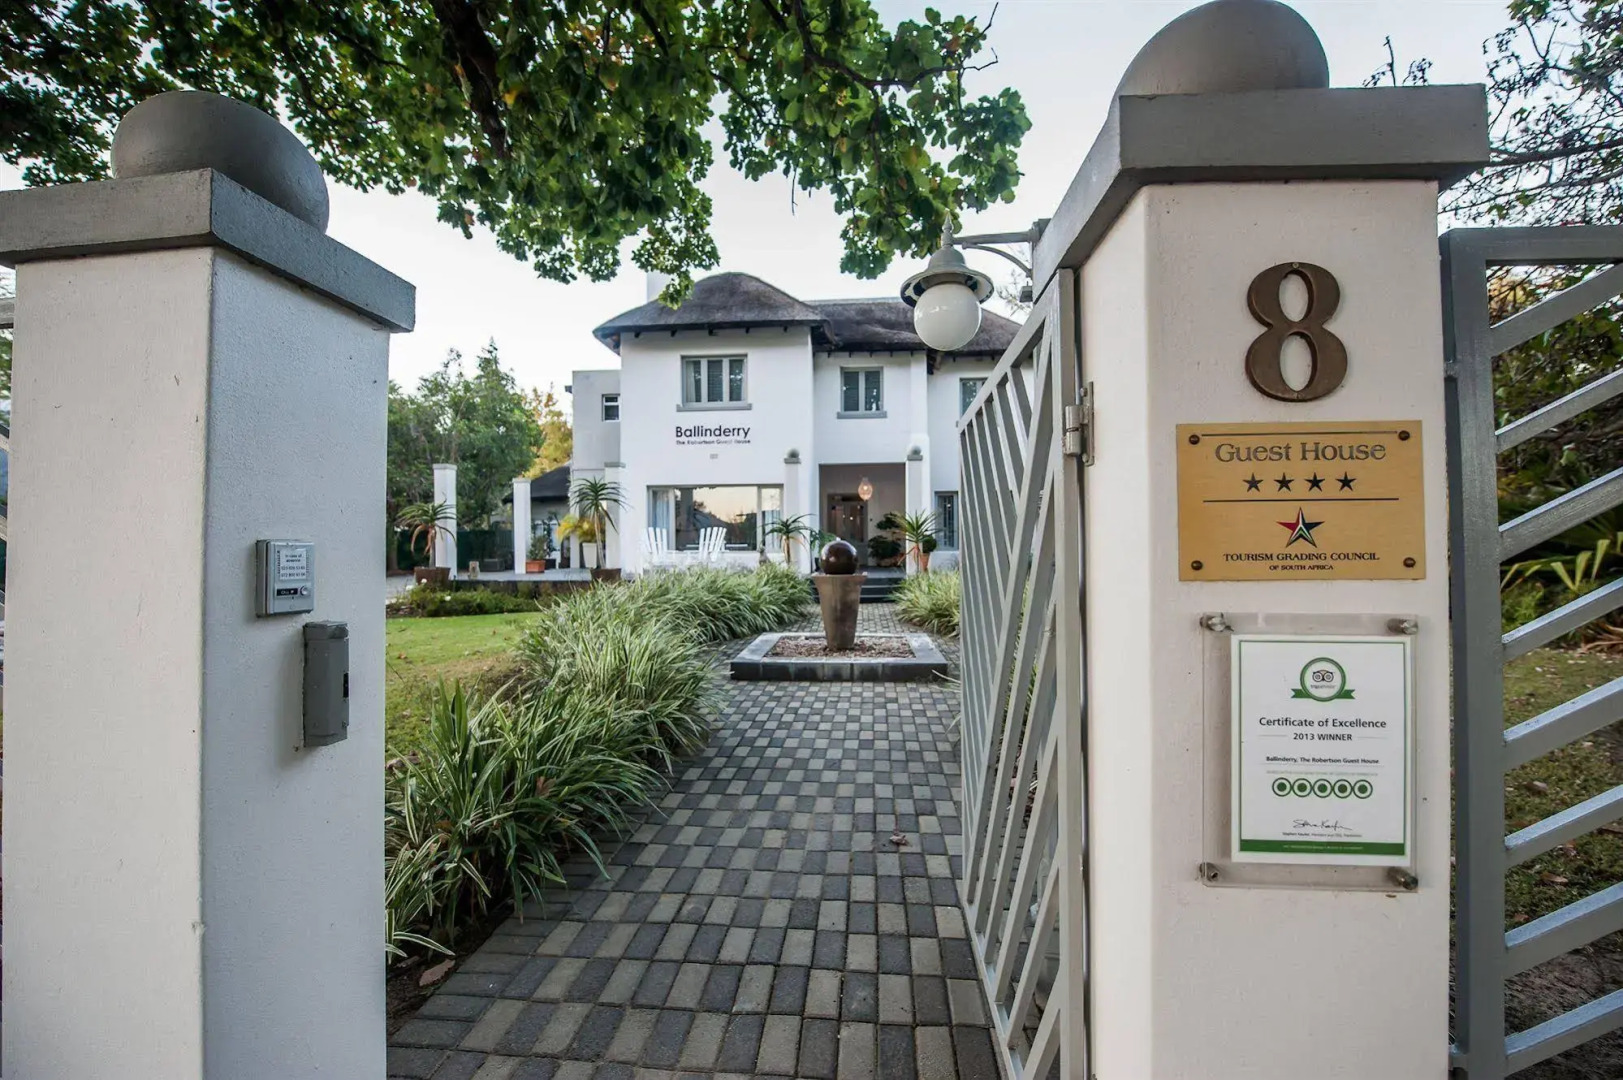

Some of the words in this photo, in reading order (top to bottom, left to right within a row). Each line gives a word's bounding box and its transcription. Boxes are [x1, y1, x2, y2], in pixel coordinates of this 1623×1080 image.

[1245, 261, 1348, 403] 8
[675, 424, 751, 439] Ballinderry
[1215, 442, 1292, 462] Guest
[1300, 442, 1387, 461] House
[1223, 552, 1274, 562] TOURISM
[1276, 552, 1327, 561] GRADING
[1330, 552, 1380, 561] COUNCIL
[1259, 716, 1315, 727] Certificate
[1317, 718, 1329, 727] of
[1332, 718, 1387, 728] Excellence
[1293, 732, 1315, 741] 2013
[1317, 733, 1353, 741] WINNER
